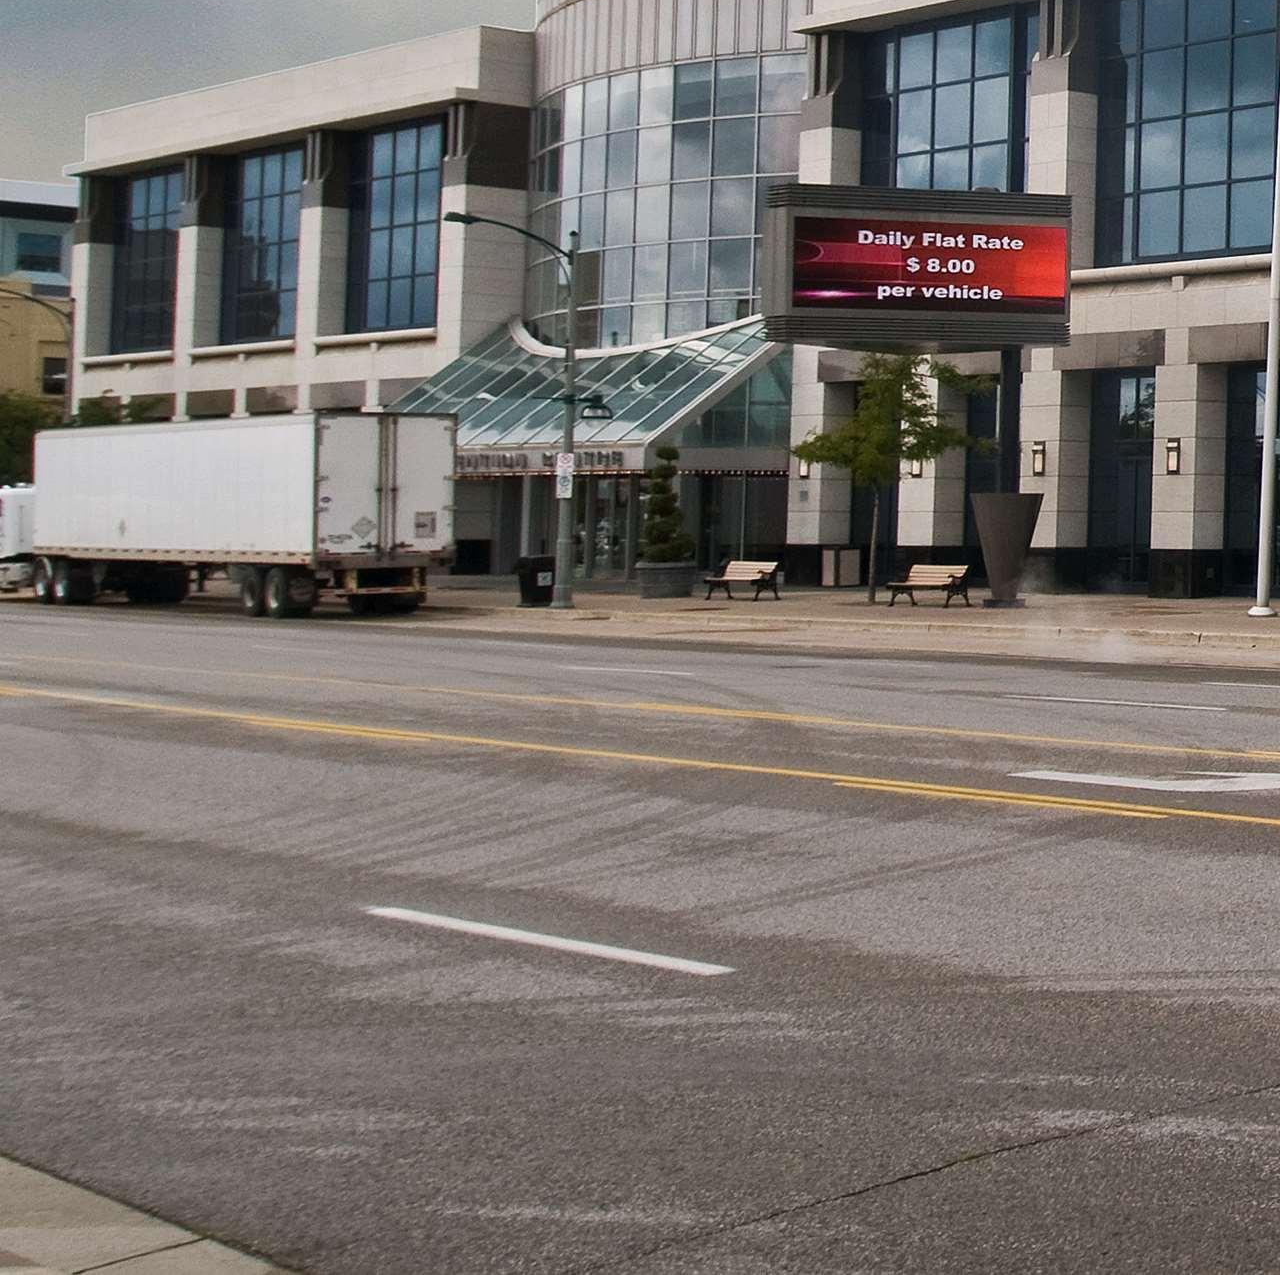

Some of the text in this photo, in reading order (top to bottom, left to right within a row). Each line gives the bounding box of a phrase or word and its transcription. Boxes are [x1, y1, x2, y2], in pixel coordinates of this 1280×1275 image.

[858, 230, 1024, 250] Daily Flat Rate
[906, 257, 975, 274] $ 8.00
[877, 284, 1003, 300] per vehicle
